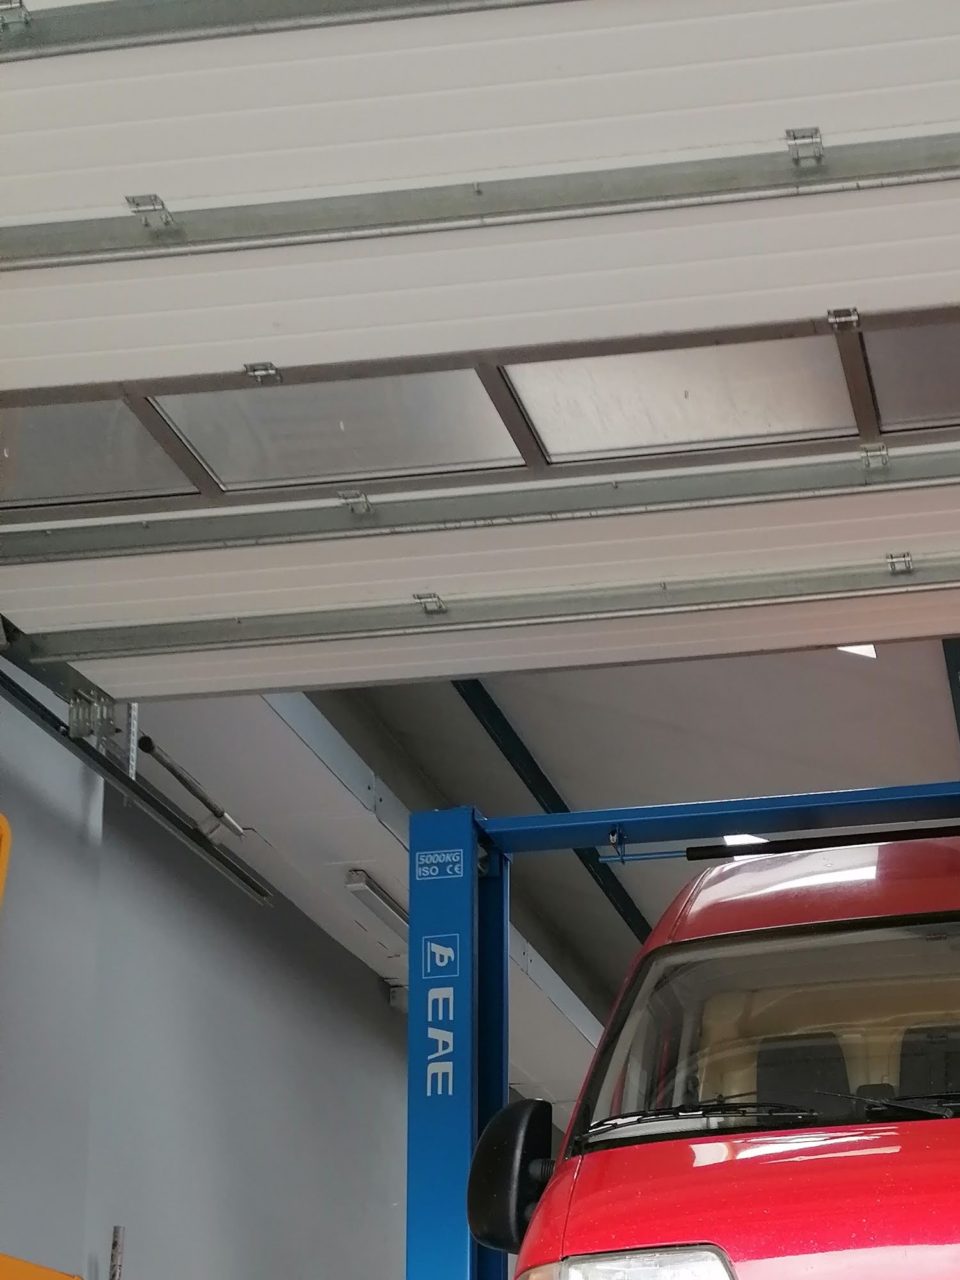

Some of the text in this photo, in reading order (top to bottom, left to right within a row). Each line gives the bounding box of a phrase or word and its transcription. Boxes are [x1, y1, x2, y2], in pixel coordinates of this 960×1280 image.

[418, 852, 461, 864] 5000KG
[418, 866, 439, 877] ISO
[426, 987, 454, 1097] EAE
